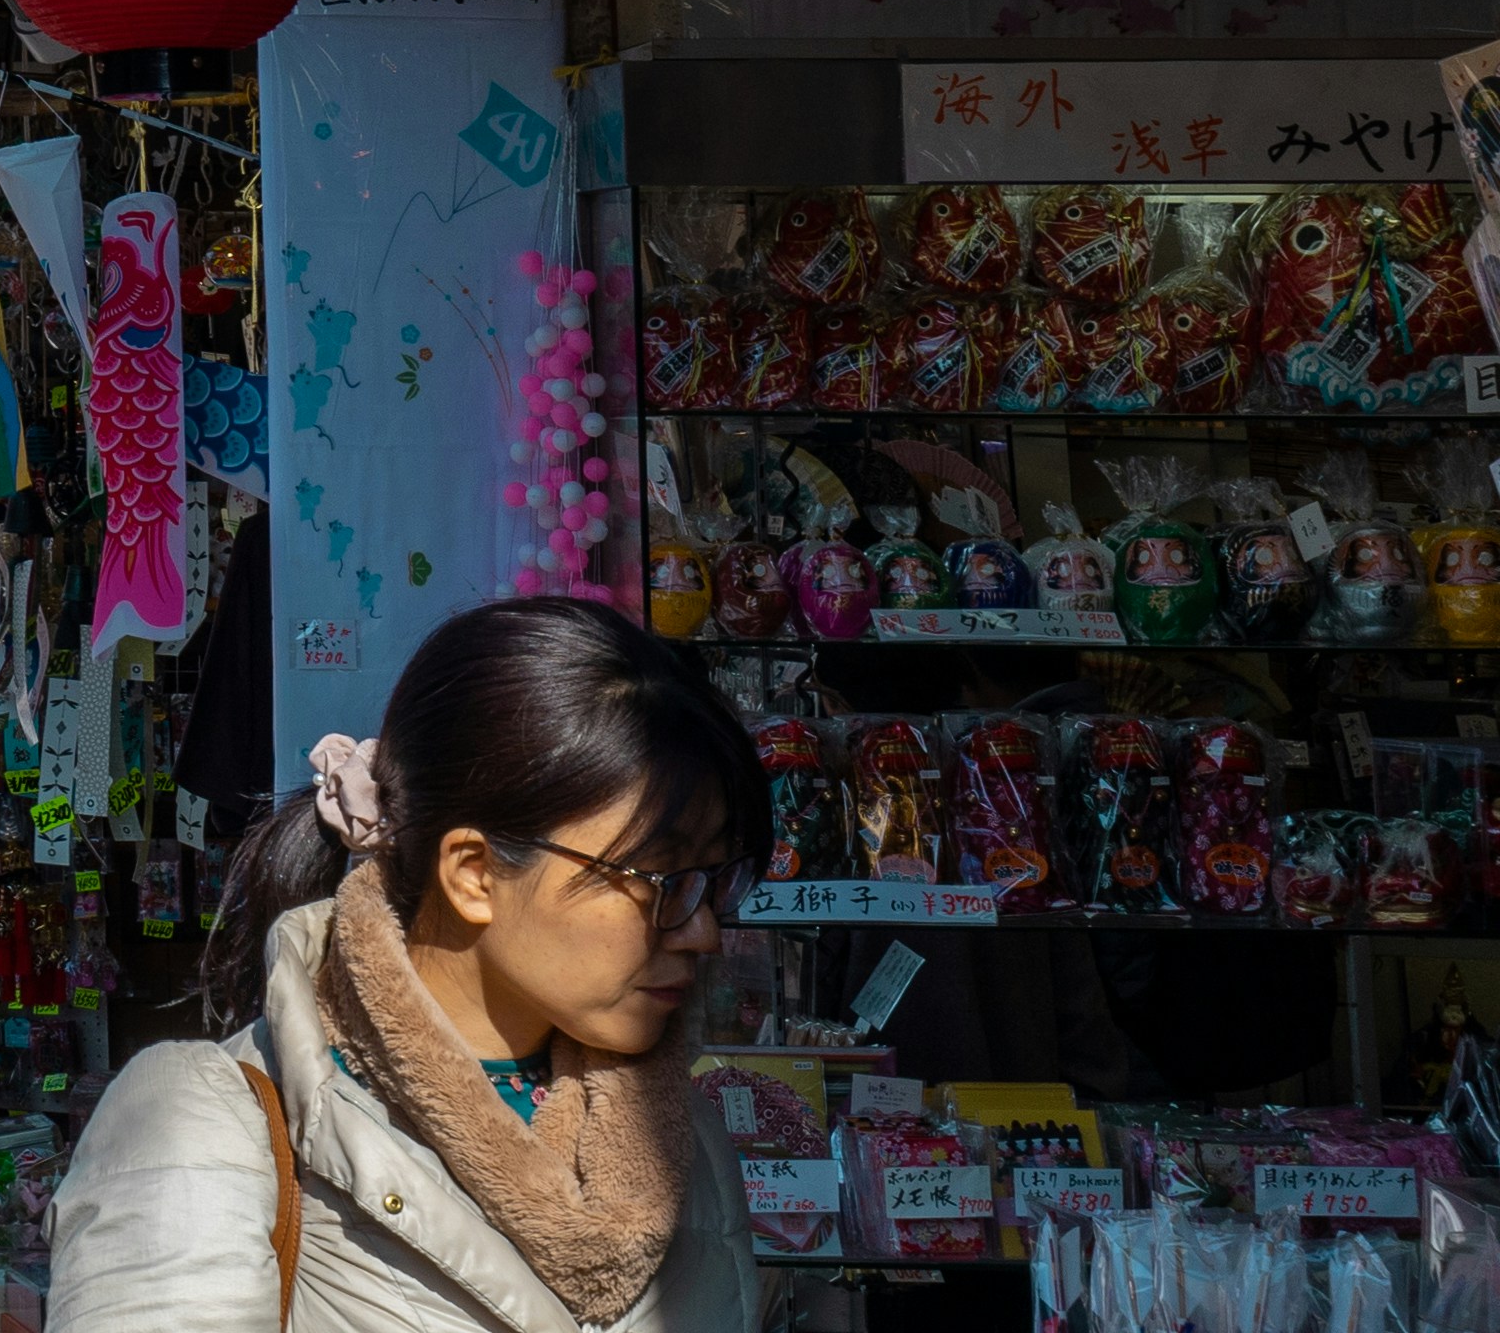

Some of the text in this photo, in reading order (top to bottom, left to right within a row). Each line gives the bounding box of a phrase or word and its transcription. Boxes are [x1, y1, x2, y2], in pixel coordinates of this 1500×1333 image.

[933, 68, 1074, 131] 海外
[1111, 115, 1227, 176] 浅草
[750, 886, 880, 915] 立獅子
[922, 892, 994, 917] ¥3700
[888, 1169, 953, 1185] ボールペン付
[1021, 1171, 1122, 1187] しおり Bookmark
[892, 1185, 957, 1209] メモ帳
